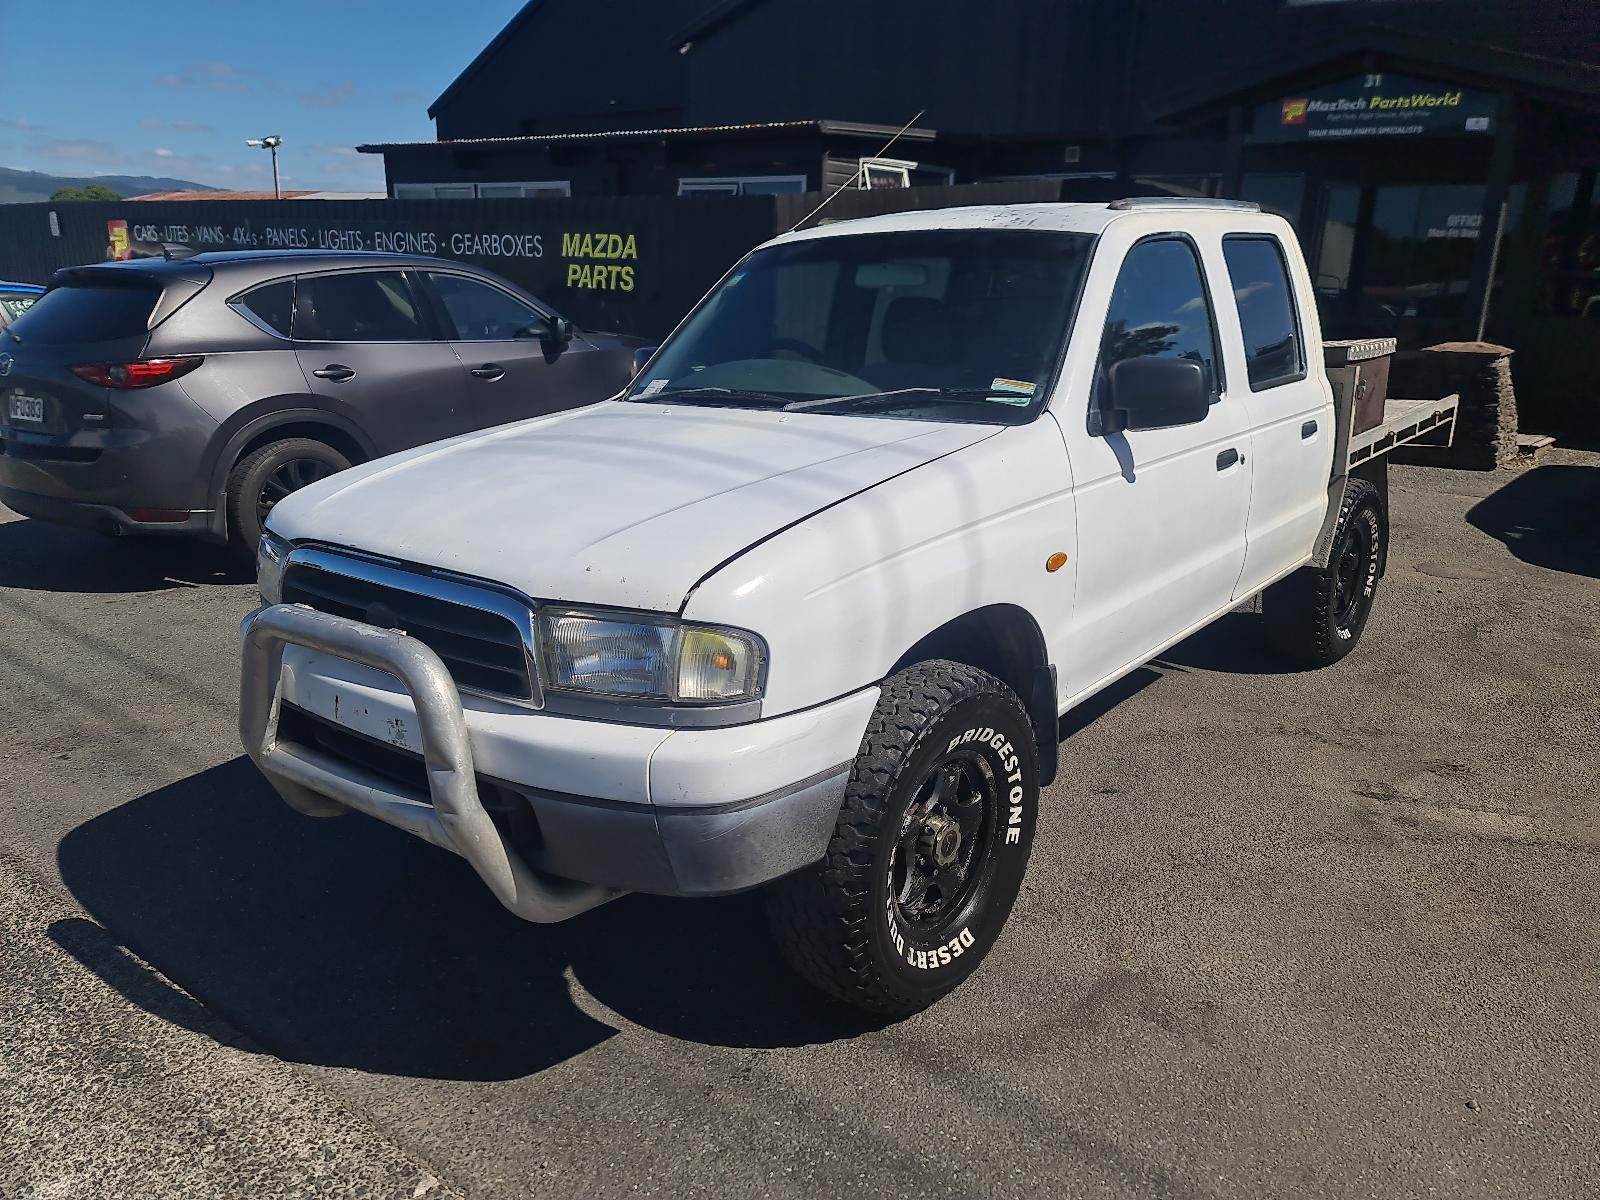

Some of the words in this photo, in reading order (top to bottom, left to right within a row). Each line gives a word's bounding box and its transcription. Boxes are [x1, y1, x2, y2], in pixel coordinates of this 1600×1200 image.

[1363, 73, 1382, 88] 31
[1369, 91, 1462, 110] PartsWorld
[133, 224, 159, 242] CARS
[164, 225, 189, 243] UTES
[195, 226, 225, 245] VANS
[265, 227, 309, 248] PANELS
[318, 229, 364, 250] LIGHTS
[375, 231, 437, 254] ENGINES
[452, 233, 544, 258] GEARBOXES
[561, 232, 638, 260] MAZDA
[567, 263, 635, 292] PARTS
[946, 727, 1023, 845] BRIDGESTONE
[906, 926, 976, 969] DESERT
